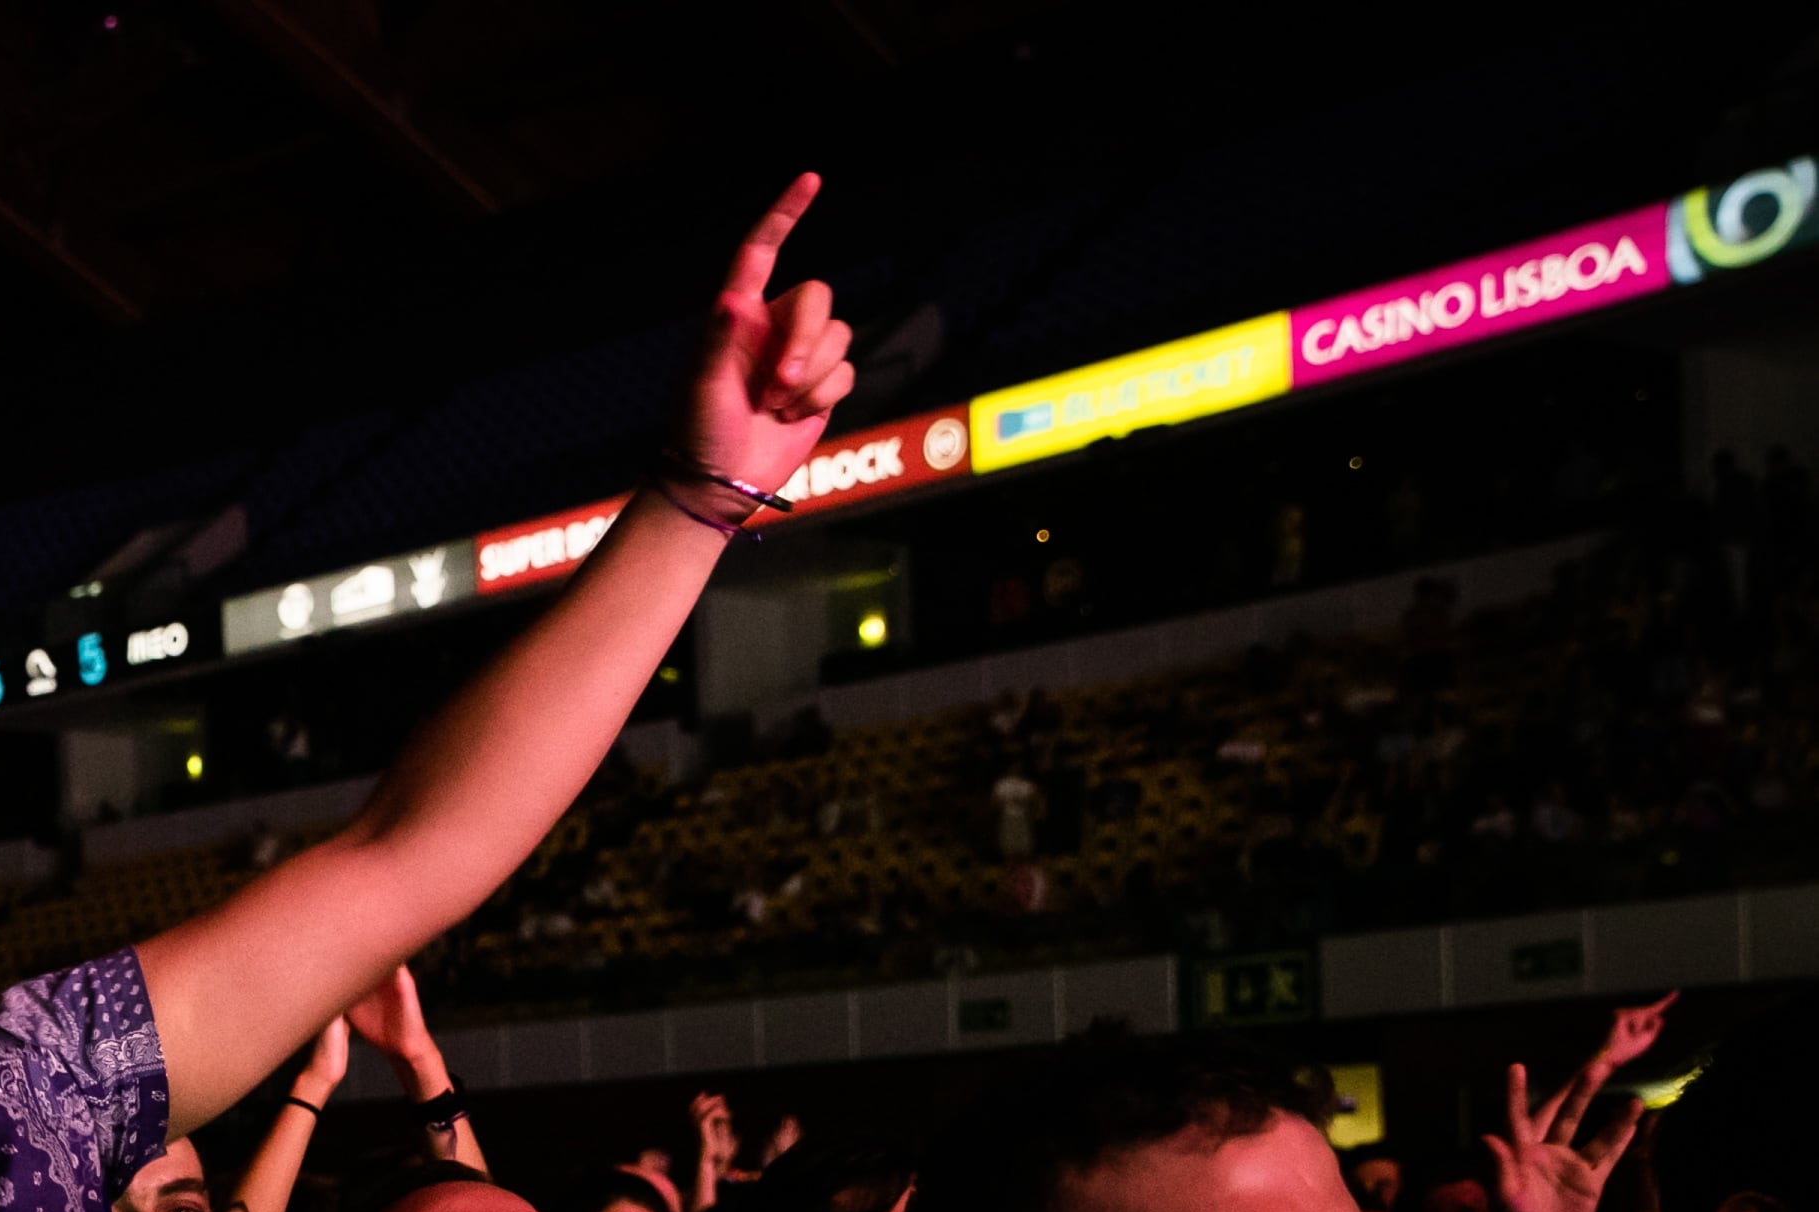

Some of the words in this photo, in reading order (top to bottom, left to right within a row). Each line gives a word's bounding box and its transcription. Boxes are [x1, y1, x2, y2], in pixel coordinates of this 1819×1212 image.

[1301, 282, 1476, 365] CASINO
[1480, 236, 1648, 318] LISBOA
[809, 437, 905, 496] BOCK
[479, 527, 567, 582] SUPER
[565, 513, 619, 560] BO
